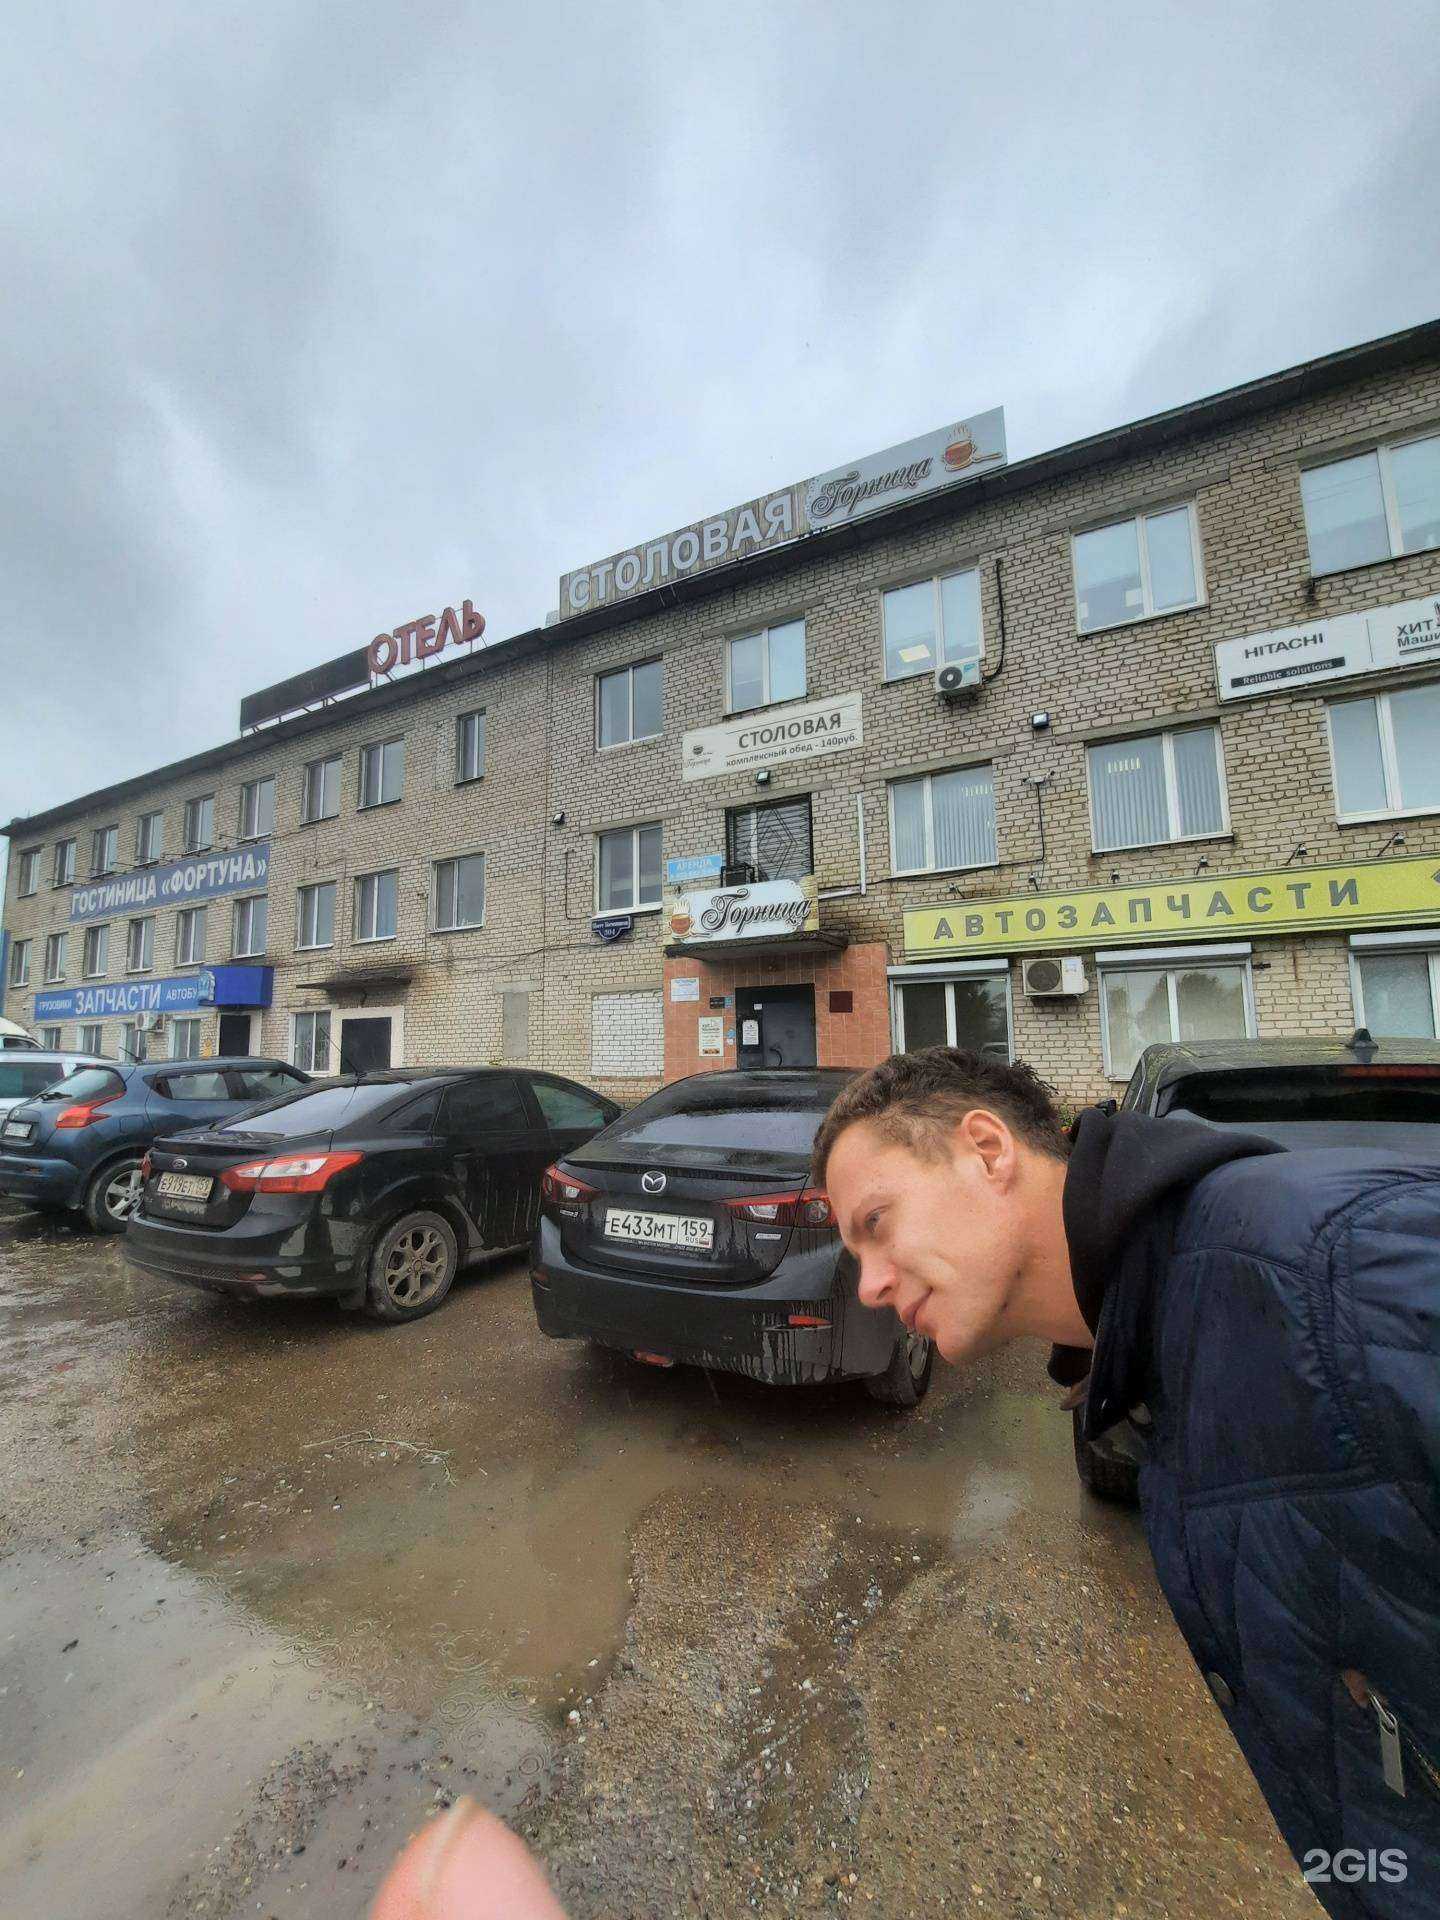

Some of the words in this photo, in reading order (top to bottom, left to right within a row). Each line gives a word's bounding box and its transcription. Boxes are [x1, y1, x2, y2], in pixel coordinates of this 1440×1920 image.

[811, 456, 934, 518] Горница
[569, 493, 794, 609] СТОЛОВАЯ
[368, 599, 486, 674] ОТЕЛЬ
[1244, 632, 1325, 659] HITACHI
[1242, 672, 1282, 686] Reliable
[1285, 661, 1334, 678] solutions
[738, 712, 842, 749] СТОЛОВАЯ
[725, 746, 788, 767] комплексный
[789, 743, 813, 755] обед
[71, 875, 157, 915] ГОСТИНИЦА
[161, 853, 267, 895] «ФОРТУНА»
[700, 888, 814, 935] Горница
[932, 878, 1360, 941] АВТОЗАПЧАСТИ
[38, 998, 72, 1011] ГРУЗОВИКИ
[74, 983, 161, 1015] ЗАПЧАСТИ
[681, 1219, 708, 1238] 159
